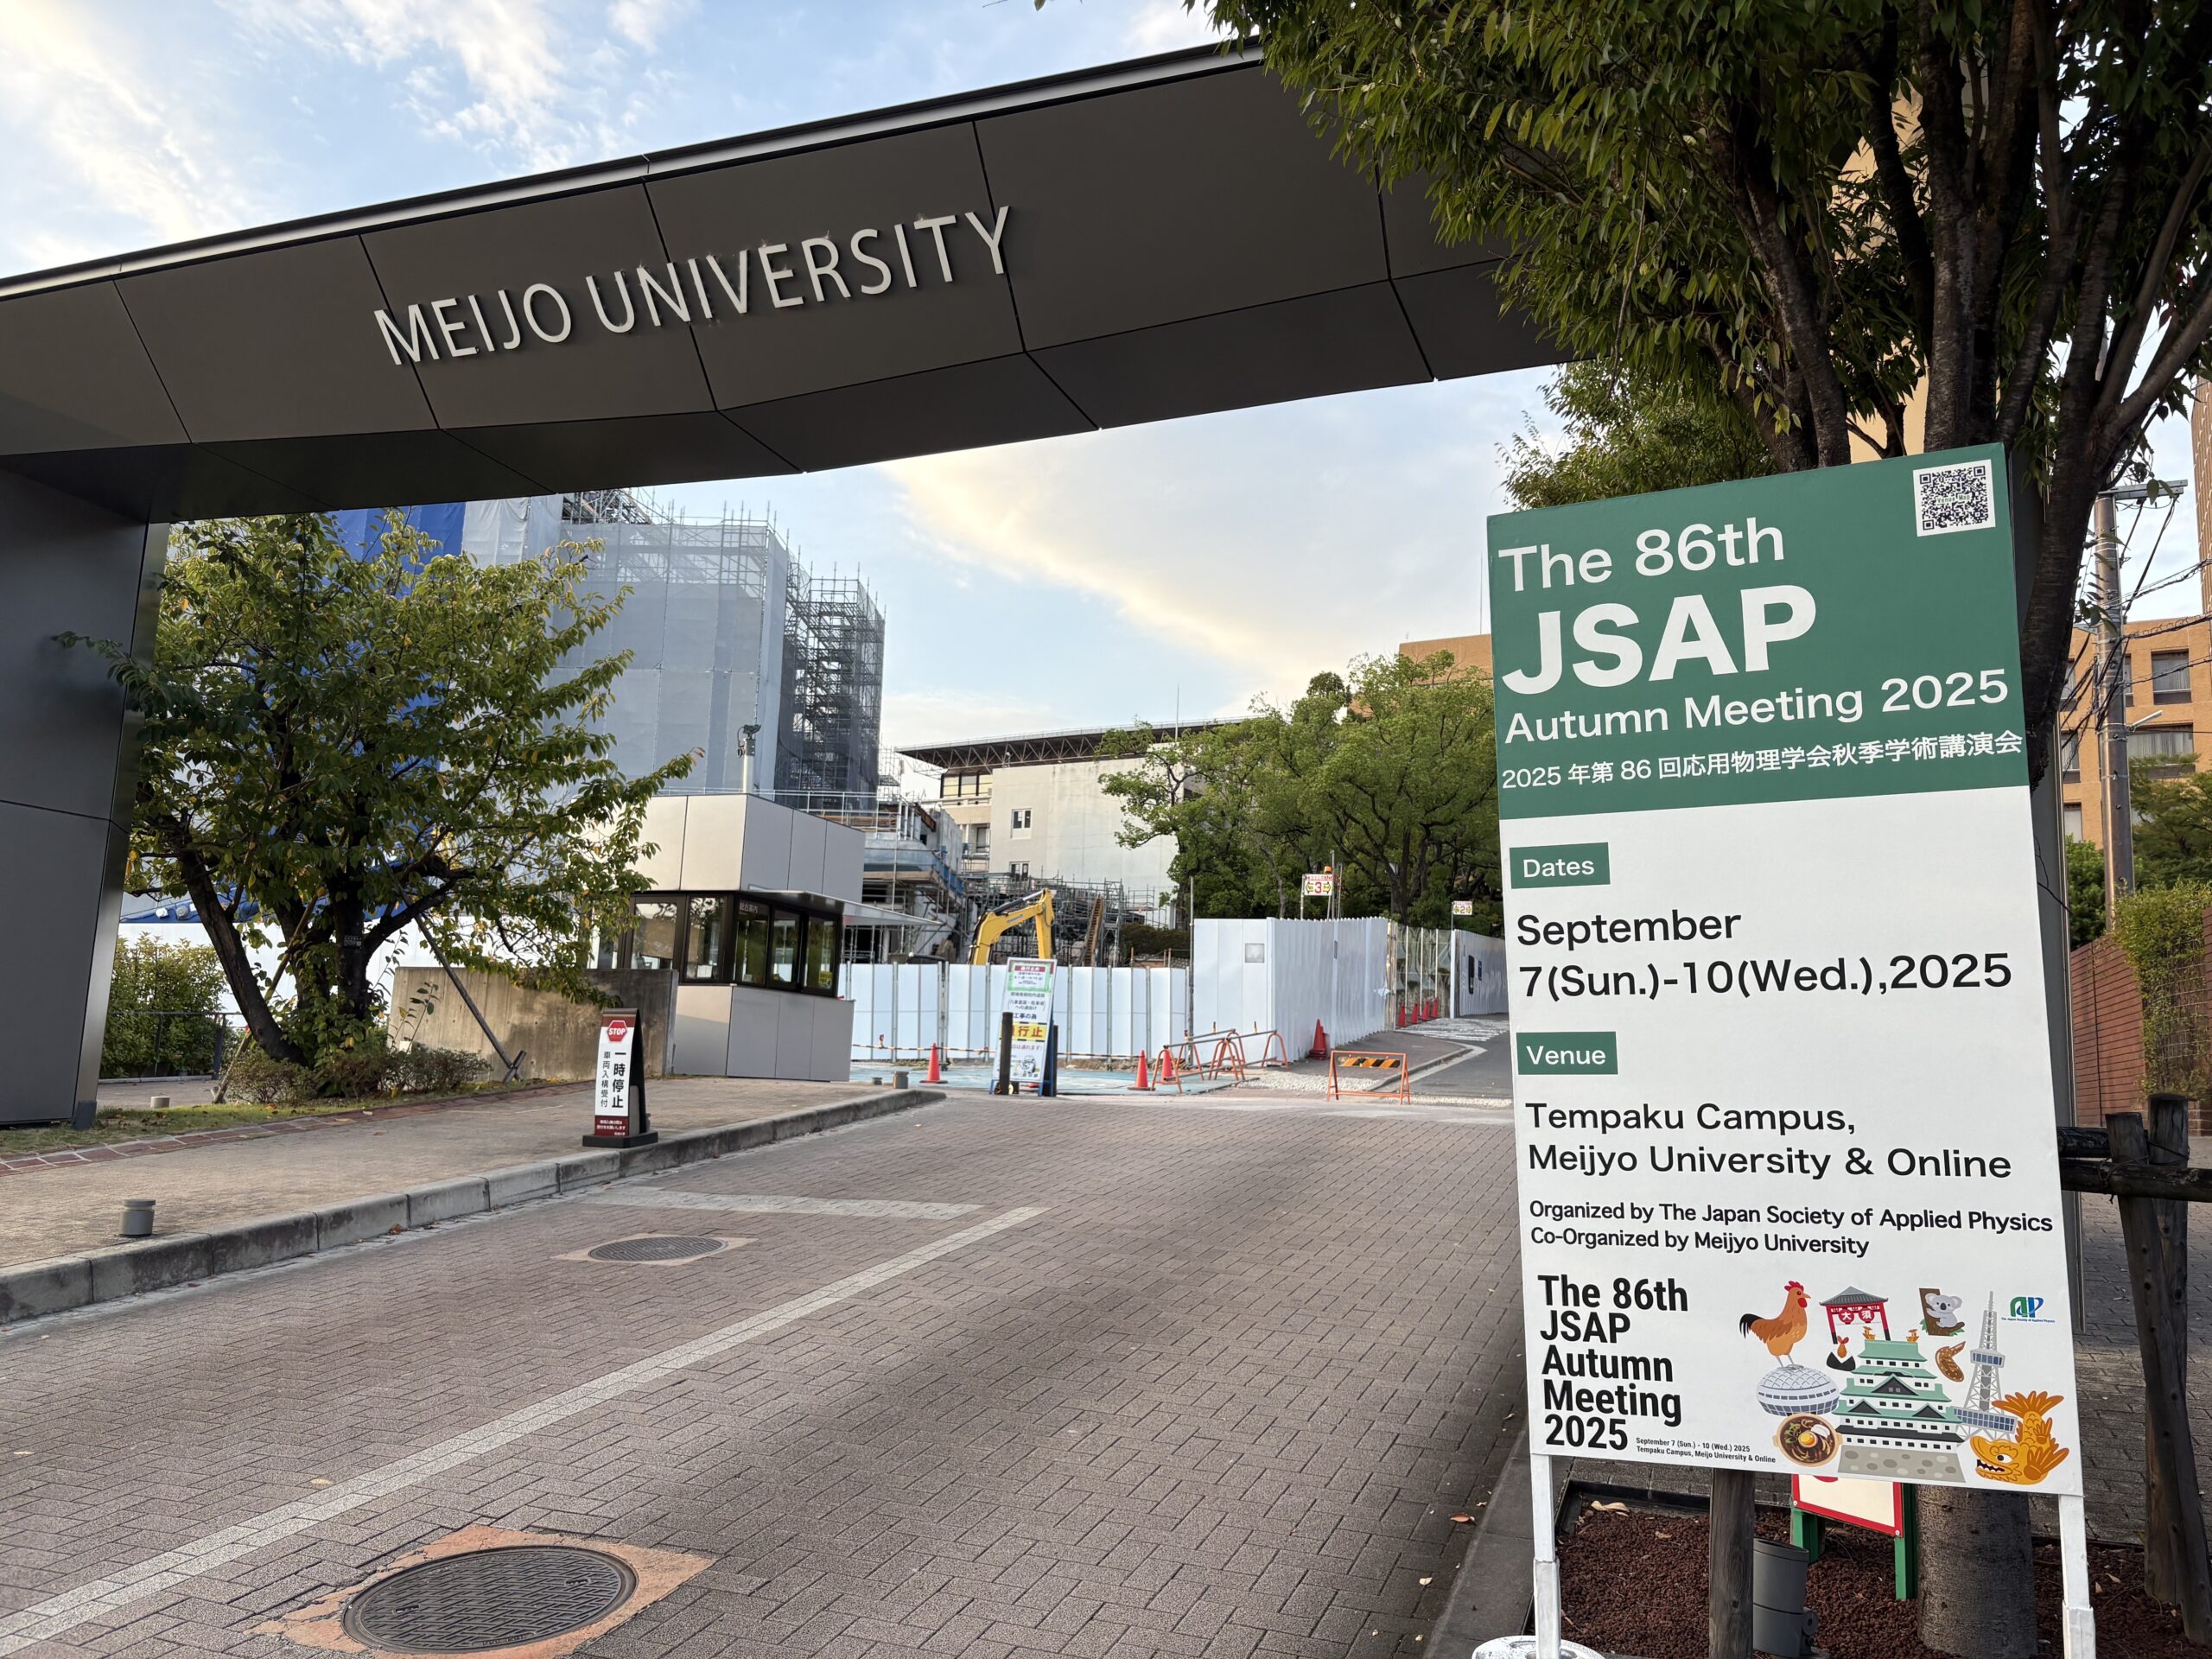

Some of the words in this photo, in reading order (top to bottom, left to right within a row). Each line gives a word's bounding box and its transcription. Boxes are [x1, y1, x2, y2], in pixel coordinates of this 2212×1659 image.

[374, 283, 571, 365] MEIJO
[586, 206, 1008, 333] UNIVERSITY
[1498, 543, 1612, 592] The
[1636, 517, 1784, 576] 86th
[1502, 585, 1816, 695] JSAP
[1504, 708, 1669, 744] Autumn
[1685, 687, 1863, 728] Meeting
[1881, 669, 2008, 712] 2025
[1503, 766, 1561, 789] 2025
[1568, 761, 1614, 785] 年第
[1621, 760, 1651, 780] 86
[1658, 730, 2023, 779] 回応用物理学会秋季学術講演会
[1314, 881, 1322, 893] 3
[1523, 859, 1594, 878] Dates
[1517, 909, 1741, 951] September
[1012, 1025, 1043, 1038] 行止
[1526, 1046, 1605, 1065] Venue
[601, 1051, 612, 1108] 車両入構受付
[612, 1052, 627, 1109] 一時停止
[1525, 1103, 1683, 1135] Tempaku
[1697, 1103, 1854, 1135] Campus,
[1529, 1144, 1637, 1176] Meijyo
[1650, 1146, 1831, 1179] University
[1846, 1147, 1874, 1175] &
[1888, 1148, 2011, 1178] Online
[1530, 1200, 1624, 1222] Organized
[1630, 1202, 1654, 1224] by
[1659, 1203, 1696, 1221] The
[1702, 1205, 1760, 1225] Japan
[1767, 1205, 1845, 1229] Society
[1851, 1208, 1873, 1225] of
[1879, 1209, 1961, 1231] Applied
[1968, 1211, 2053, 1234] Physics
[1531, 1227, 1659, 1249] Co-Organized
[1665, 1230, 1689, 1251] by
[1694, 1231, 1758, 1254] Meijyo
[1764, 1234, 1869, 1258] University
[1537, 1274, 1600, 1307] The
[1613, 1278, 1688, 1312] 86th
[1540, 1310, 1630, 1344] JSAP
[1541, 1344, 1673, 1382] Autumn
[1544, 1379, 1681, 1427] Meeting
[1545, 1414, 1628, 1451] 2025
[1636, 1437, 1669, 1446] September
[1677, 1440, 1696, 1449] (Sun.)
[1711, 1443, 1732, 1452] (Wed.)
[1637, 1446, 1665, 1454] Tempaku
[1666, 1448, 1694, 1458] Campus,
[1694, 1450, 1713, 1459] Meijo
[1713, 1452, 1746, 1462] University
